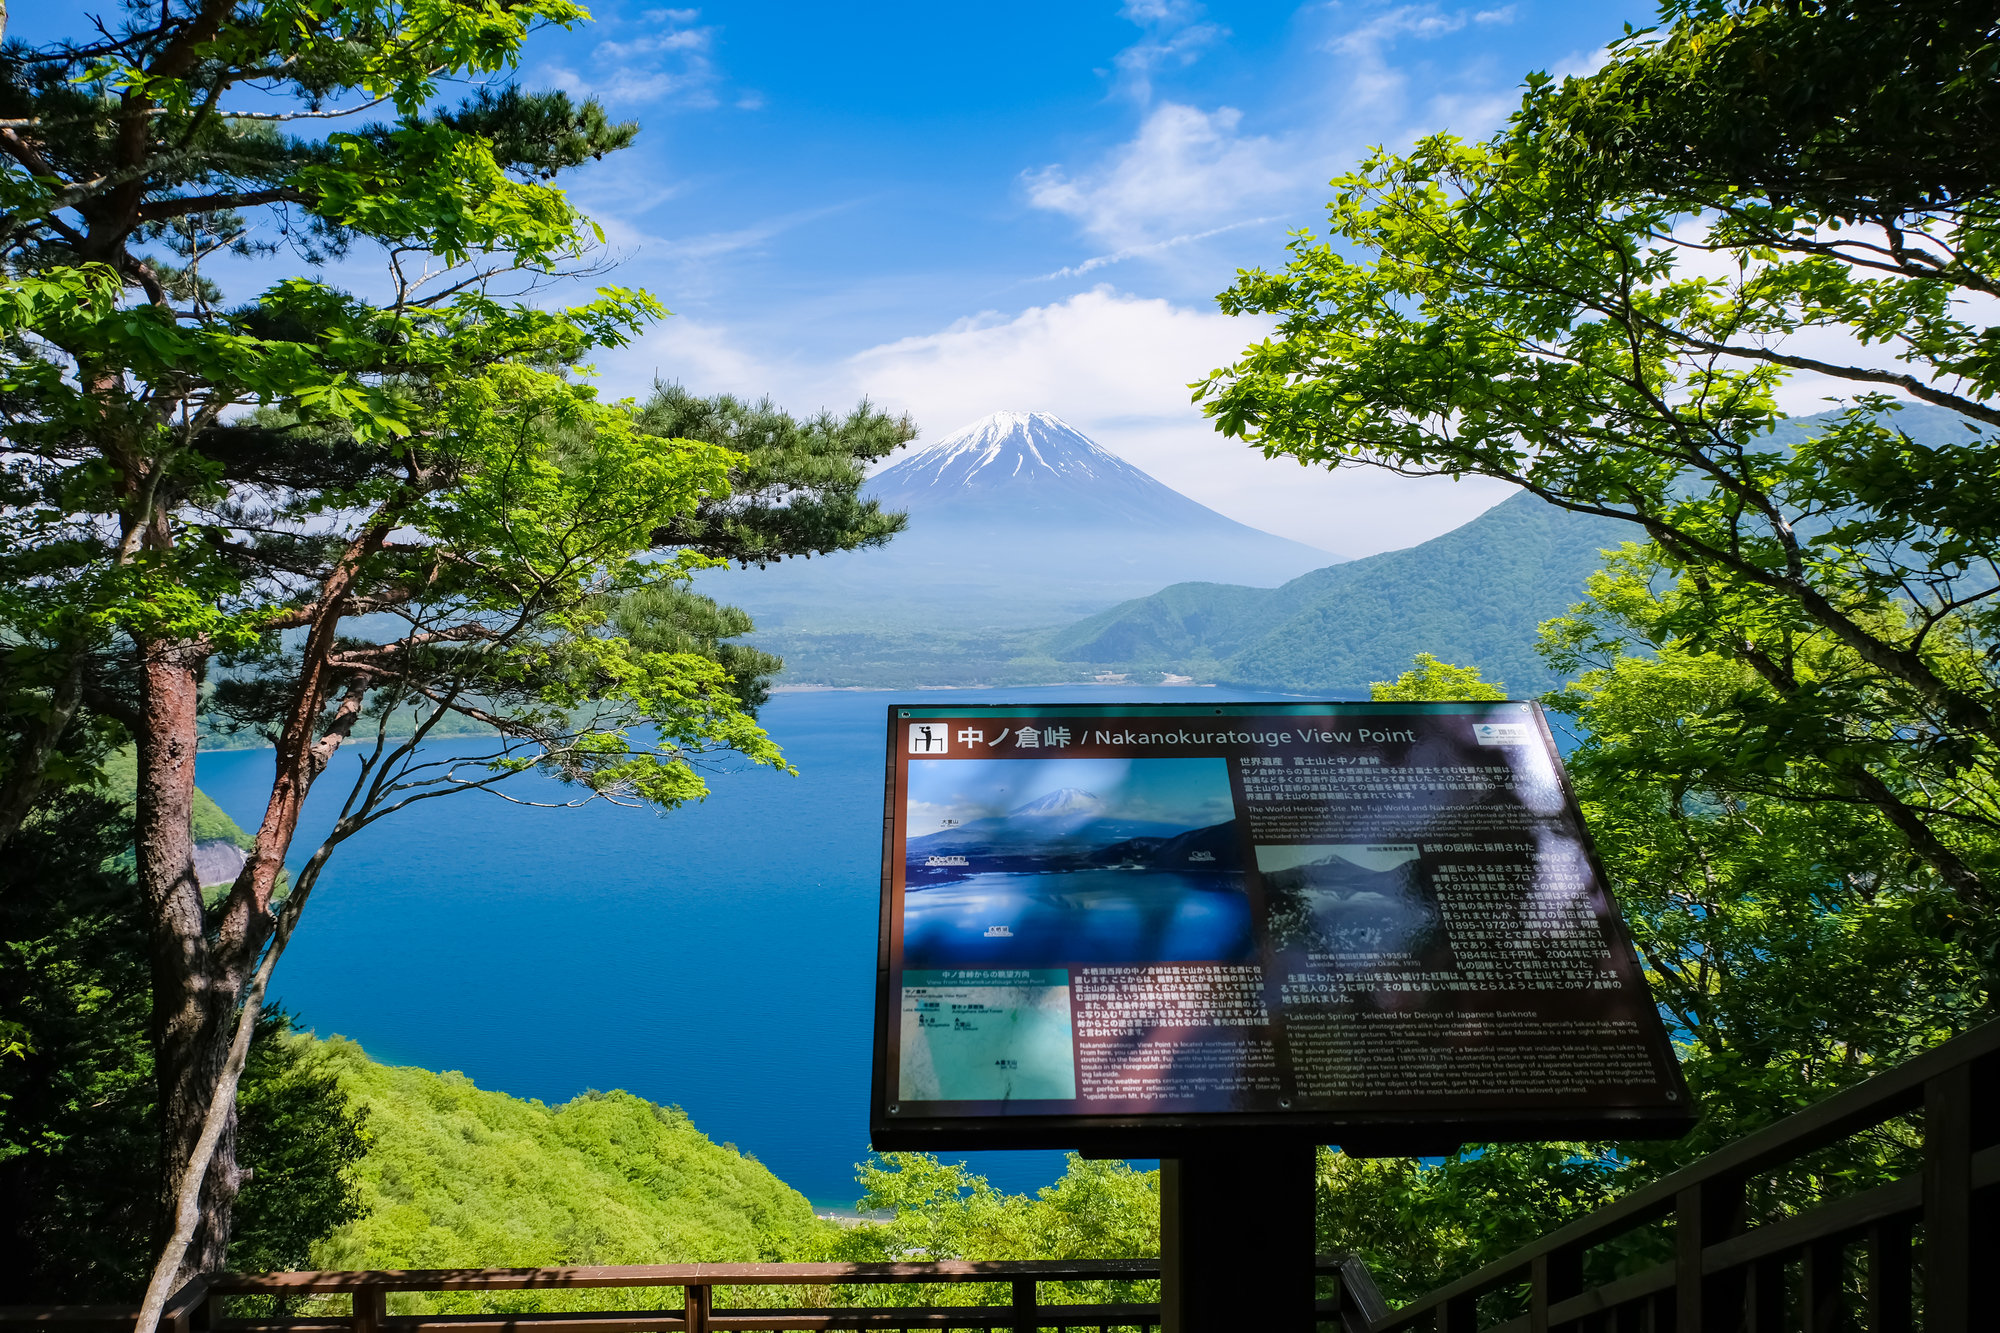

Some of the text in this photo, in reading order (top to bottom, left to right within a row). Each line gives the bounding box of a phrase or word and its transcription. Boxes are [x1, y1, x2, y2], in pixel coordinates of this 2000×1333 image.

[957, 726, 1072, 749] 中ノ倉峠
[1095, 728, 1292, 747] Nakanokuratouge
[1296, 728, 1352, 744] View
[1359, 728, 1416, 743] Point
[1240, 756, 1381, 766] 世界遺産 富士山と中ノ倉峠
[1293, 805, 1329, 813] Heritage
[1367, 804, 1382, 813] Fuji
[1430, 804, 1503, 812] Nakanokuratouge
[1328, 1012, 1359, 1022] Spring"
[1414, 1011, 1443, 1020] Design
[1457, 1010, 1494, 1020] Japanese
[1123, 1062, 1158, 1070] foreground
